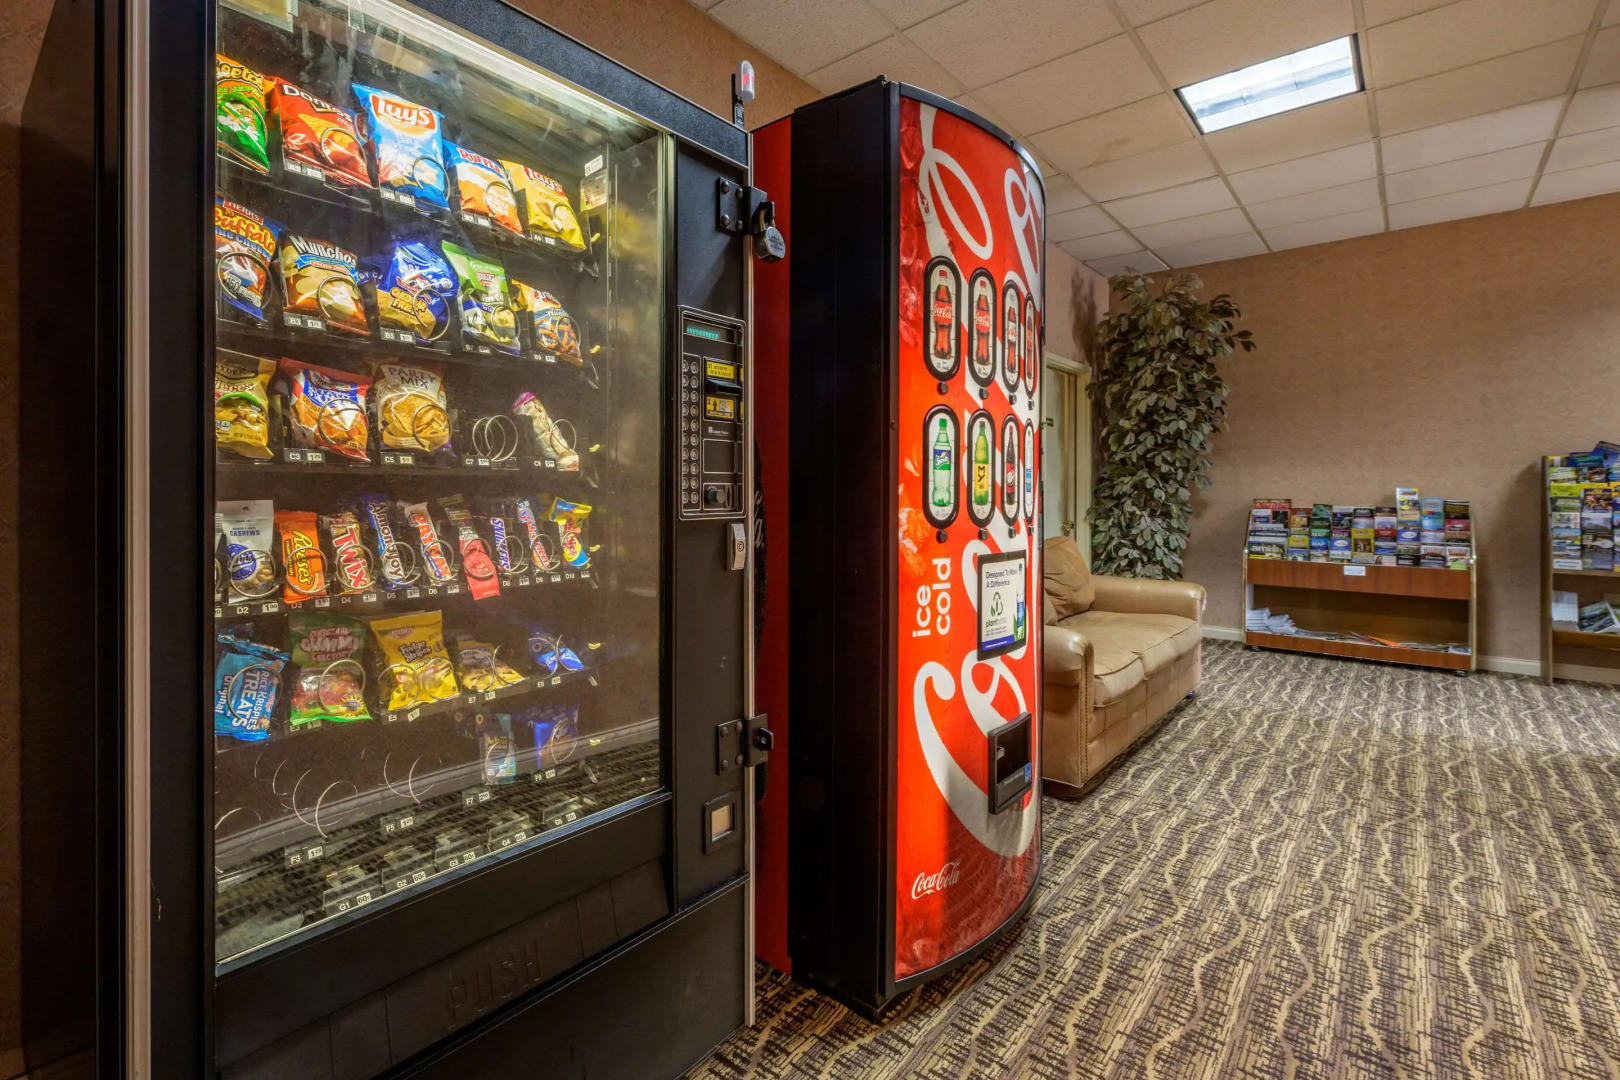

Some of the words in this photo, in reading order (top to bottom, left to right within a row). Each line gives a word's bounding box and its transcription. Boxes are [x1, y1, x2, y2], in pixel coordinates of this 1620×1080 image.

[283, 85, 353, 123] Doritos
[216, 227, 234, 240] lue
[289, 236, 357, 267] Munchos
[289, 316, 303, 326] B3
[388, 366, 436, 384] PARTY
[400, 377, 428, 392] MIX
[384, 456, 395, 464] C5
[229, 529, 261, 537] CASHEWS
[564, 572, 575, 580] D10
[985, 568, 1005, 580] Designed
[990, 579, 1011, 588] Difference
[428, 588, 438, 596] D6
[931, 557, 952, 638] cold
[291, 601, 303, 610] D3
[341, 597, 352, 605] D4
[237, 607, 249, 617] D2
[911, 584, 932, 639] ice
[310, 627, 350, 638] ORIGINAL
[300, 636, 360, 654] GUMMI
[398, 640, 432, 656] Fudge
[316, 650, 355, 662] FACTORY
[404, 647, 438, 664] Stripes
[260, 670, 270, 692] RICE
[214, 675, 233, 715] Original
[231, 670, 261, 729] TREATS
[247, 692, 268, 731] KRISPIES
[465, 797, 474, 805] F7
[386, 823, 396, 833] F5
[290, 855, 301, 865] F3
[396, 879, 408, 889] G2
[912, 856, 962, 900] Coca-Cola
[339, 901, 351, 912] G1
